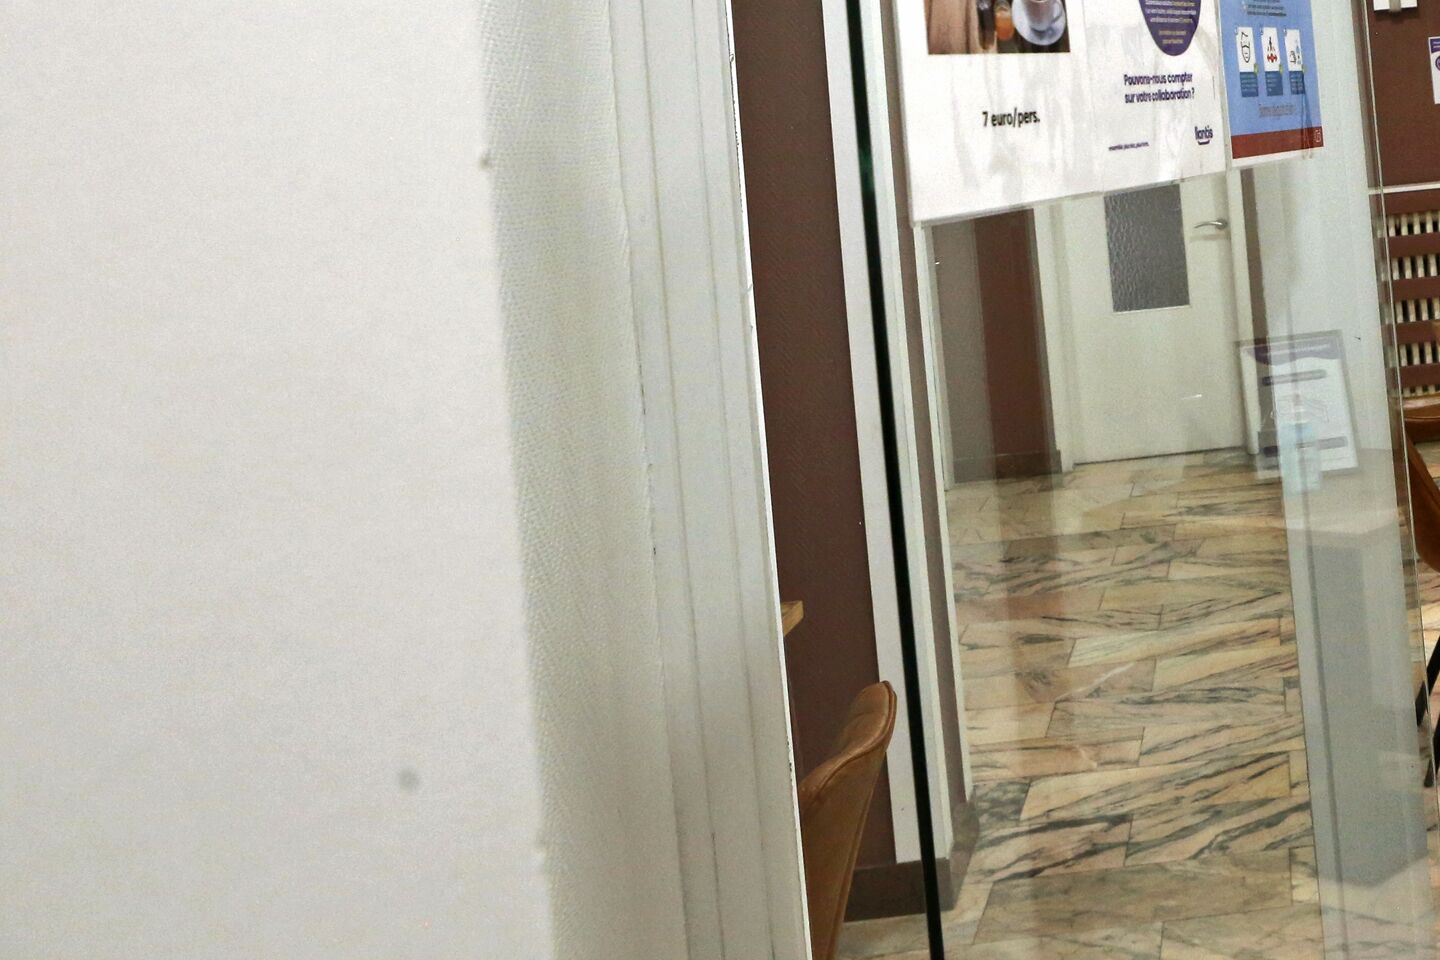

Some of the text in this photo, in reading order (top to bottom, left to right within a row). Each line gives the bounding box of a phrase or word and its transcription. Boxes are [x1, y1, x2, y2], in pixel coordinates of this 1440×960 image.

[1123, 72, 1193, 87] Pouvons-nous compter
[1124, 92, 1135, 103] sur
[1136, 91, 1151, 102] votre
[1152, 88, 1191, 102] collaboration
[982, 107, 1041, 128] 7 euro/pers.
